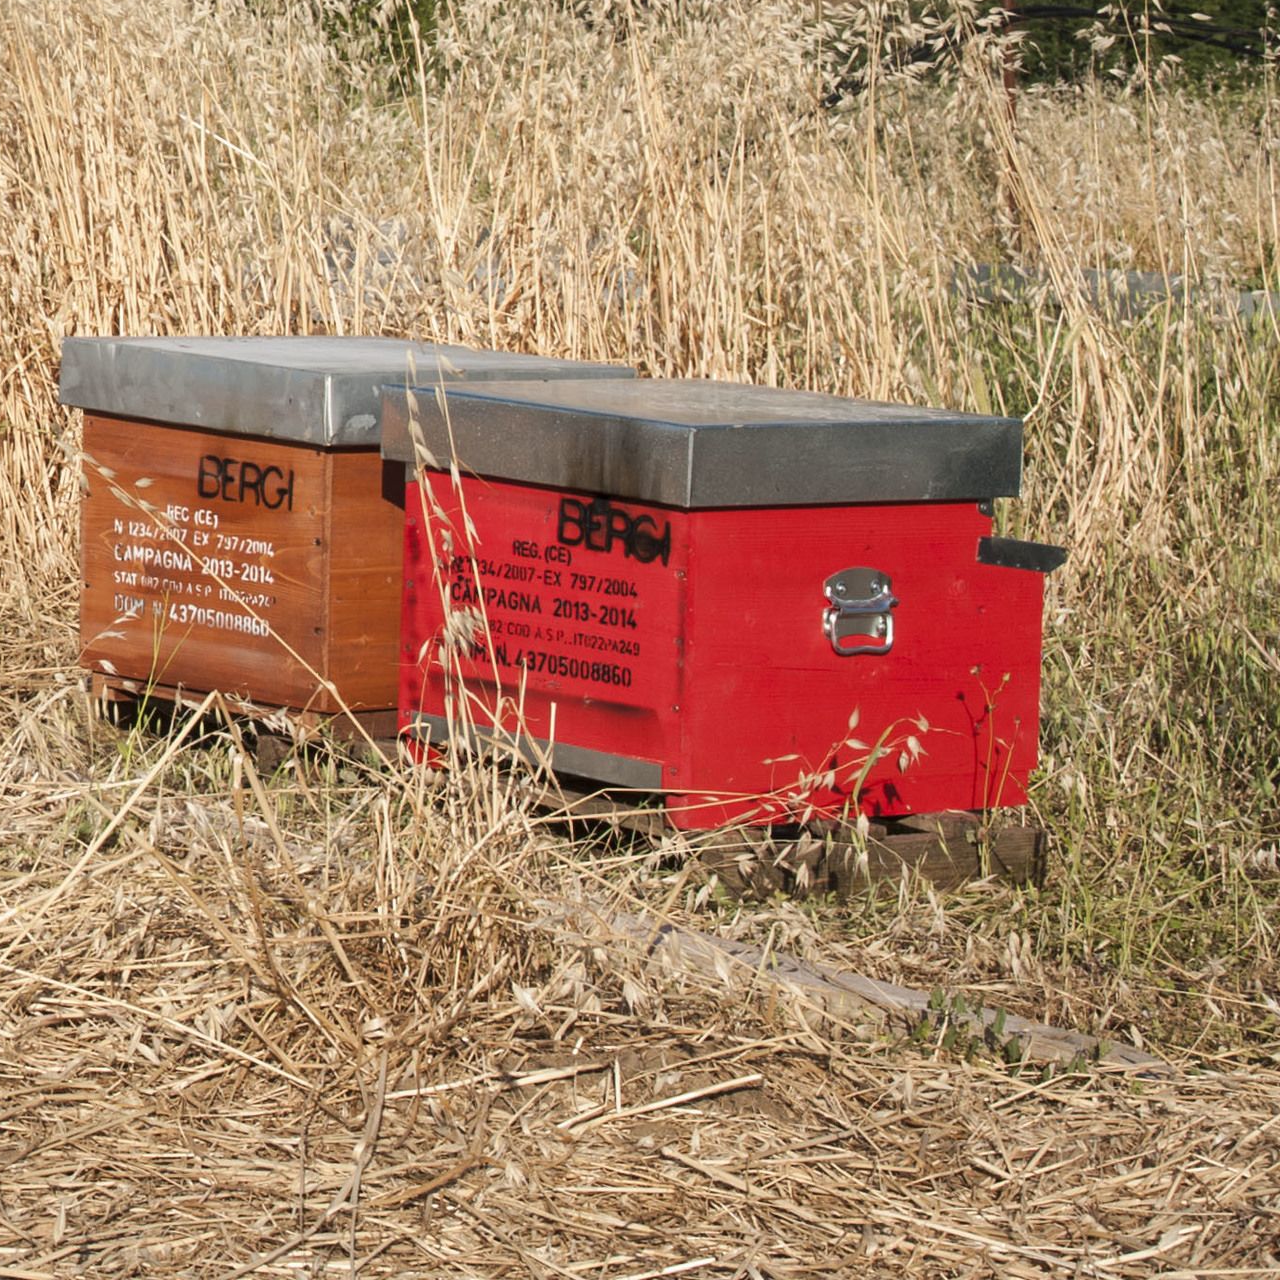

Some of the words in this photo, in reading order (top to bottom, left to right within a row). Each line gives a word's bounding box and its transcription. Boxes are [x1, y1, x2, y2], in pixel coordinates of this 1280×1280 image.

[198, 455, 294, 511] BERGI
[194, 510, 218, 528] (CE)
[558, 497, 671, 567] BERGI
[193, 531, 209, 546] EX
[217, 534, 274, 558] 797/2004
[512, 540, 541, 560] REG.
[545, 546, 572, 566] (CE)
[114, 543, 192, 572] CAMPAGNA
[201, 556, 274, 584] 2013-2014
[114, 570, 137, 586] STAT
[571, 572, 637, 598] 797/2004
[169, 603, 270, 637] 43705008860
[553, 599, 637, 630] 2013-2014
[515, 649, 632, 688] 43705008860
